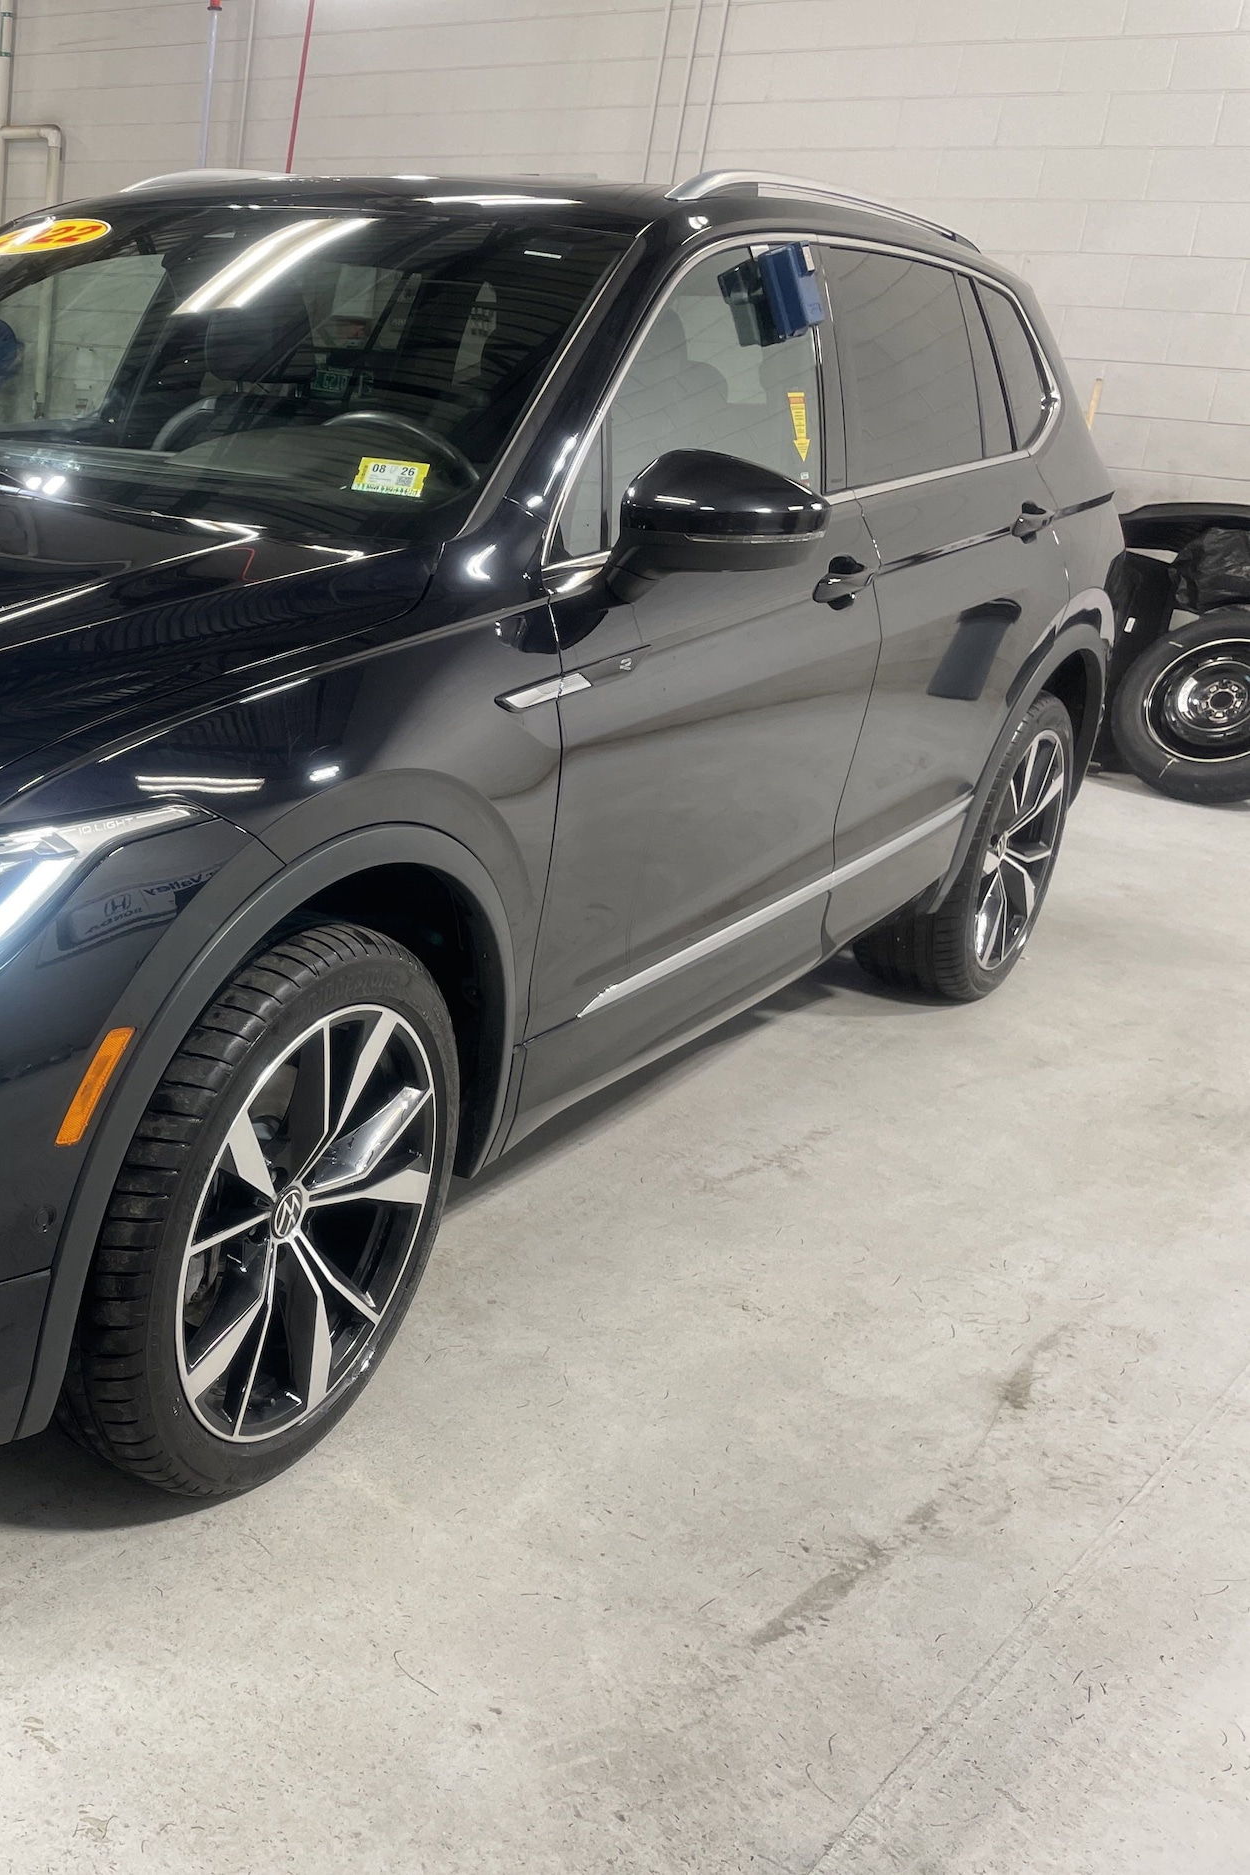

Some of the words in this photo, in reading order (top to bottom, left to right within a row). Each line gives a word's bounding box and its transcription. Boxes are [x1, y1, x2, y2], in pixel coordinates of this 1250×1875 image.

[372, 463, 387, 474] 08
[400, 466, 416, 477] 26
[77, 817, 134, 835] IQ.LIGHT
